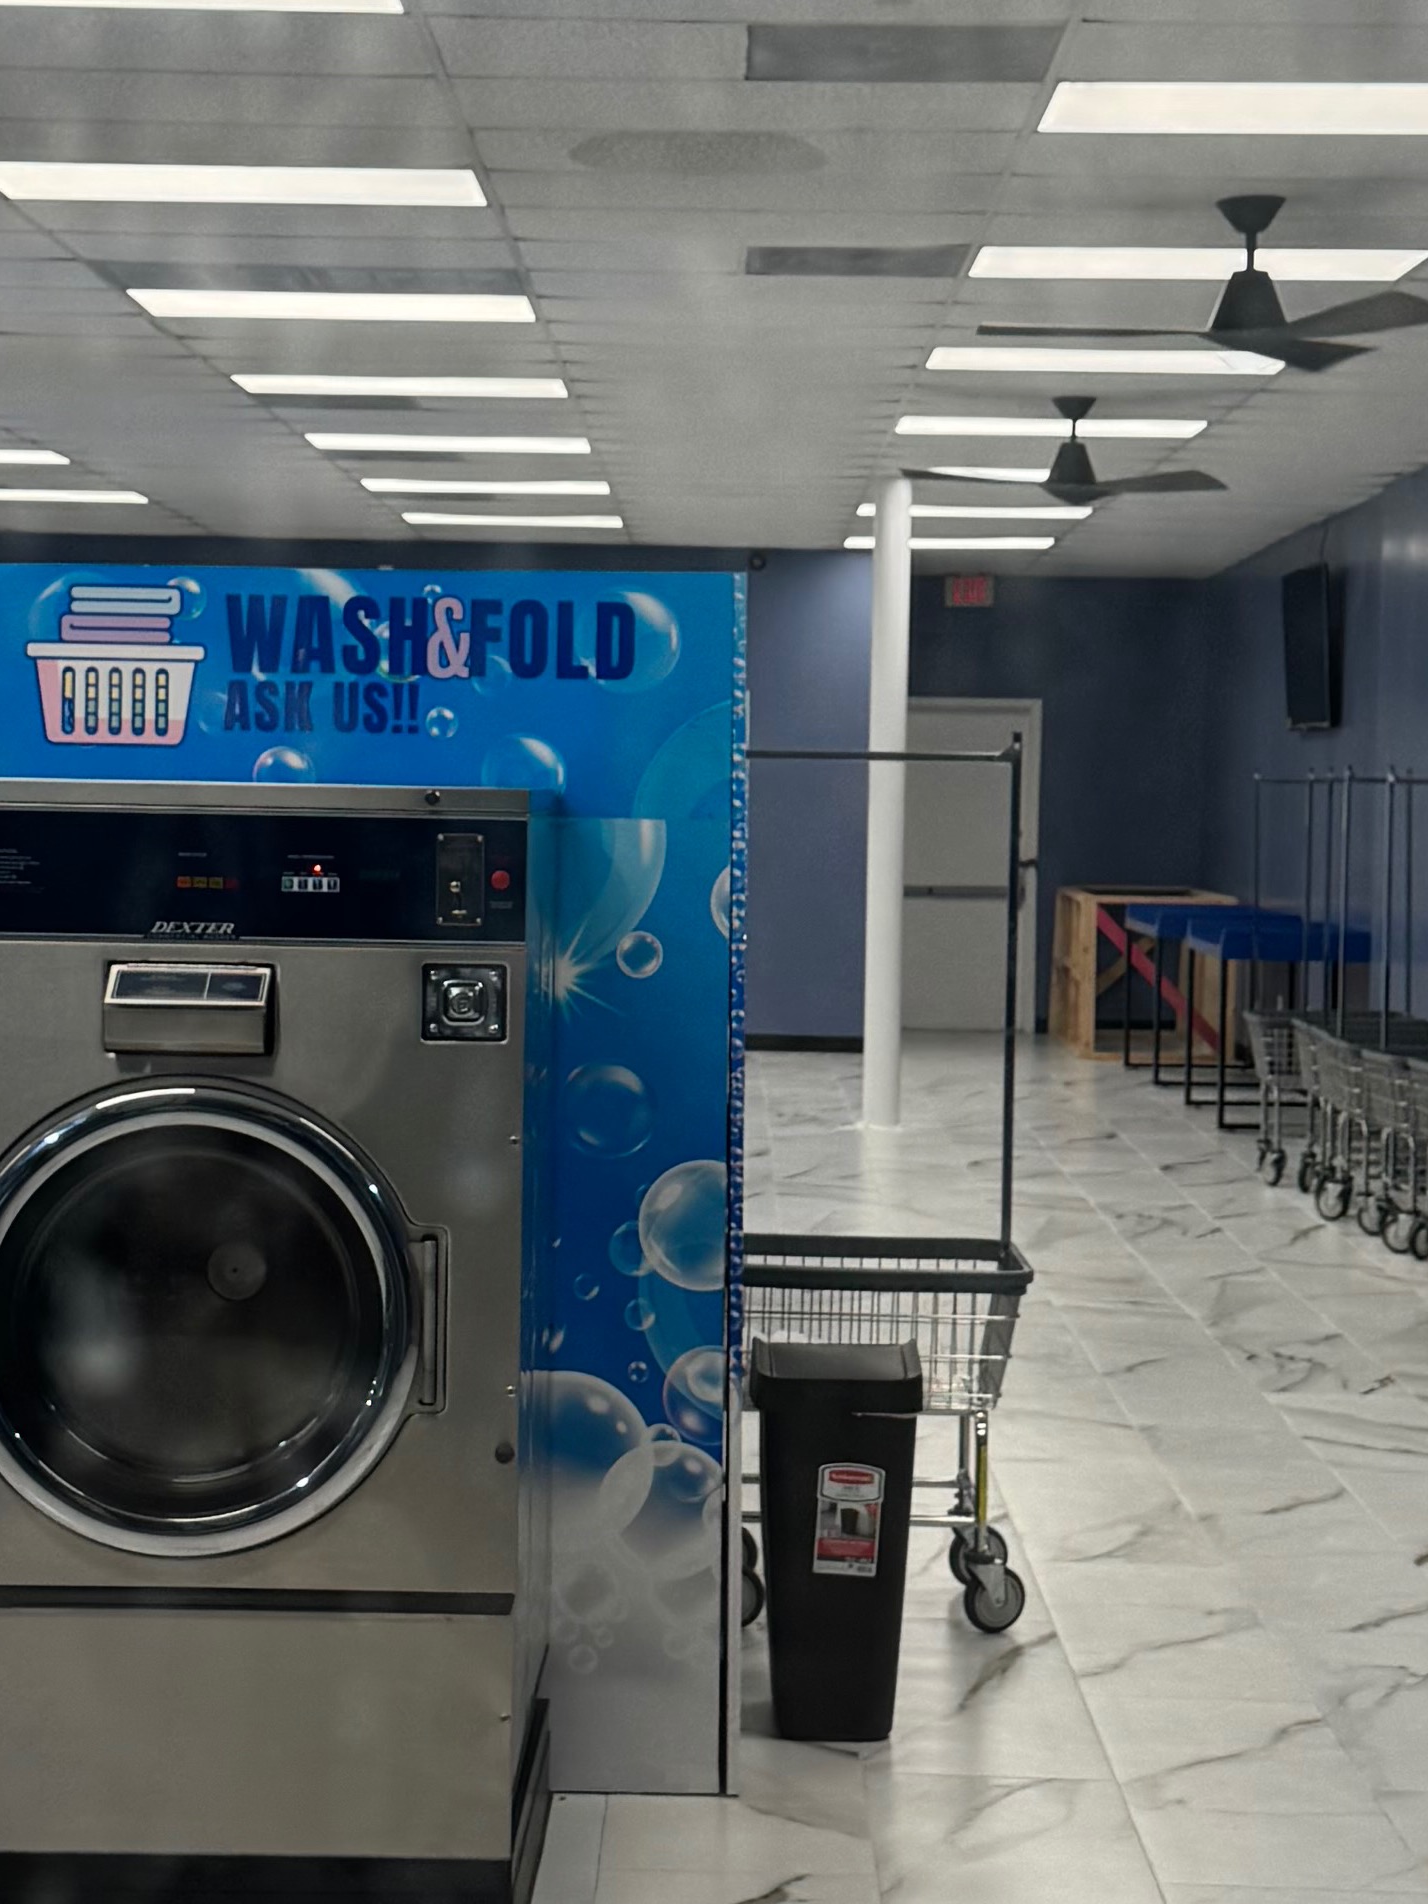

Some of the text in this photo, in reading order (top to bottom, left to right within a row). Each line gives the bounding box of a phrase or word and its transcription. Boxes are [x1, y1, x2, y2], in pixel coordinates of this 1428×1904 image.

[224, 681, 420, 734] ASK US!!
[150, 921, 235, 935] DEXTER
